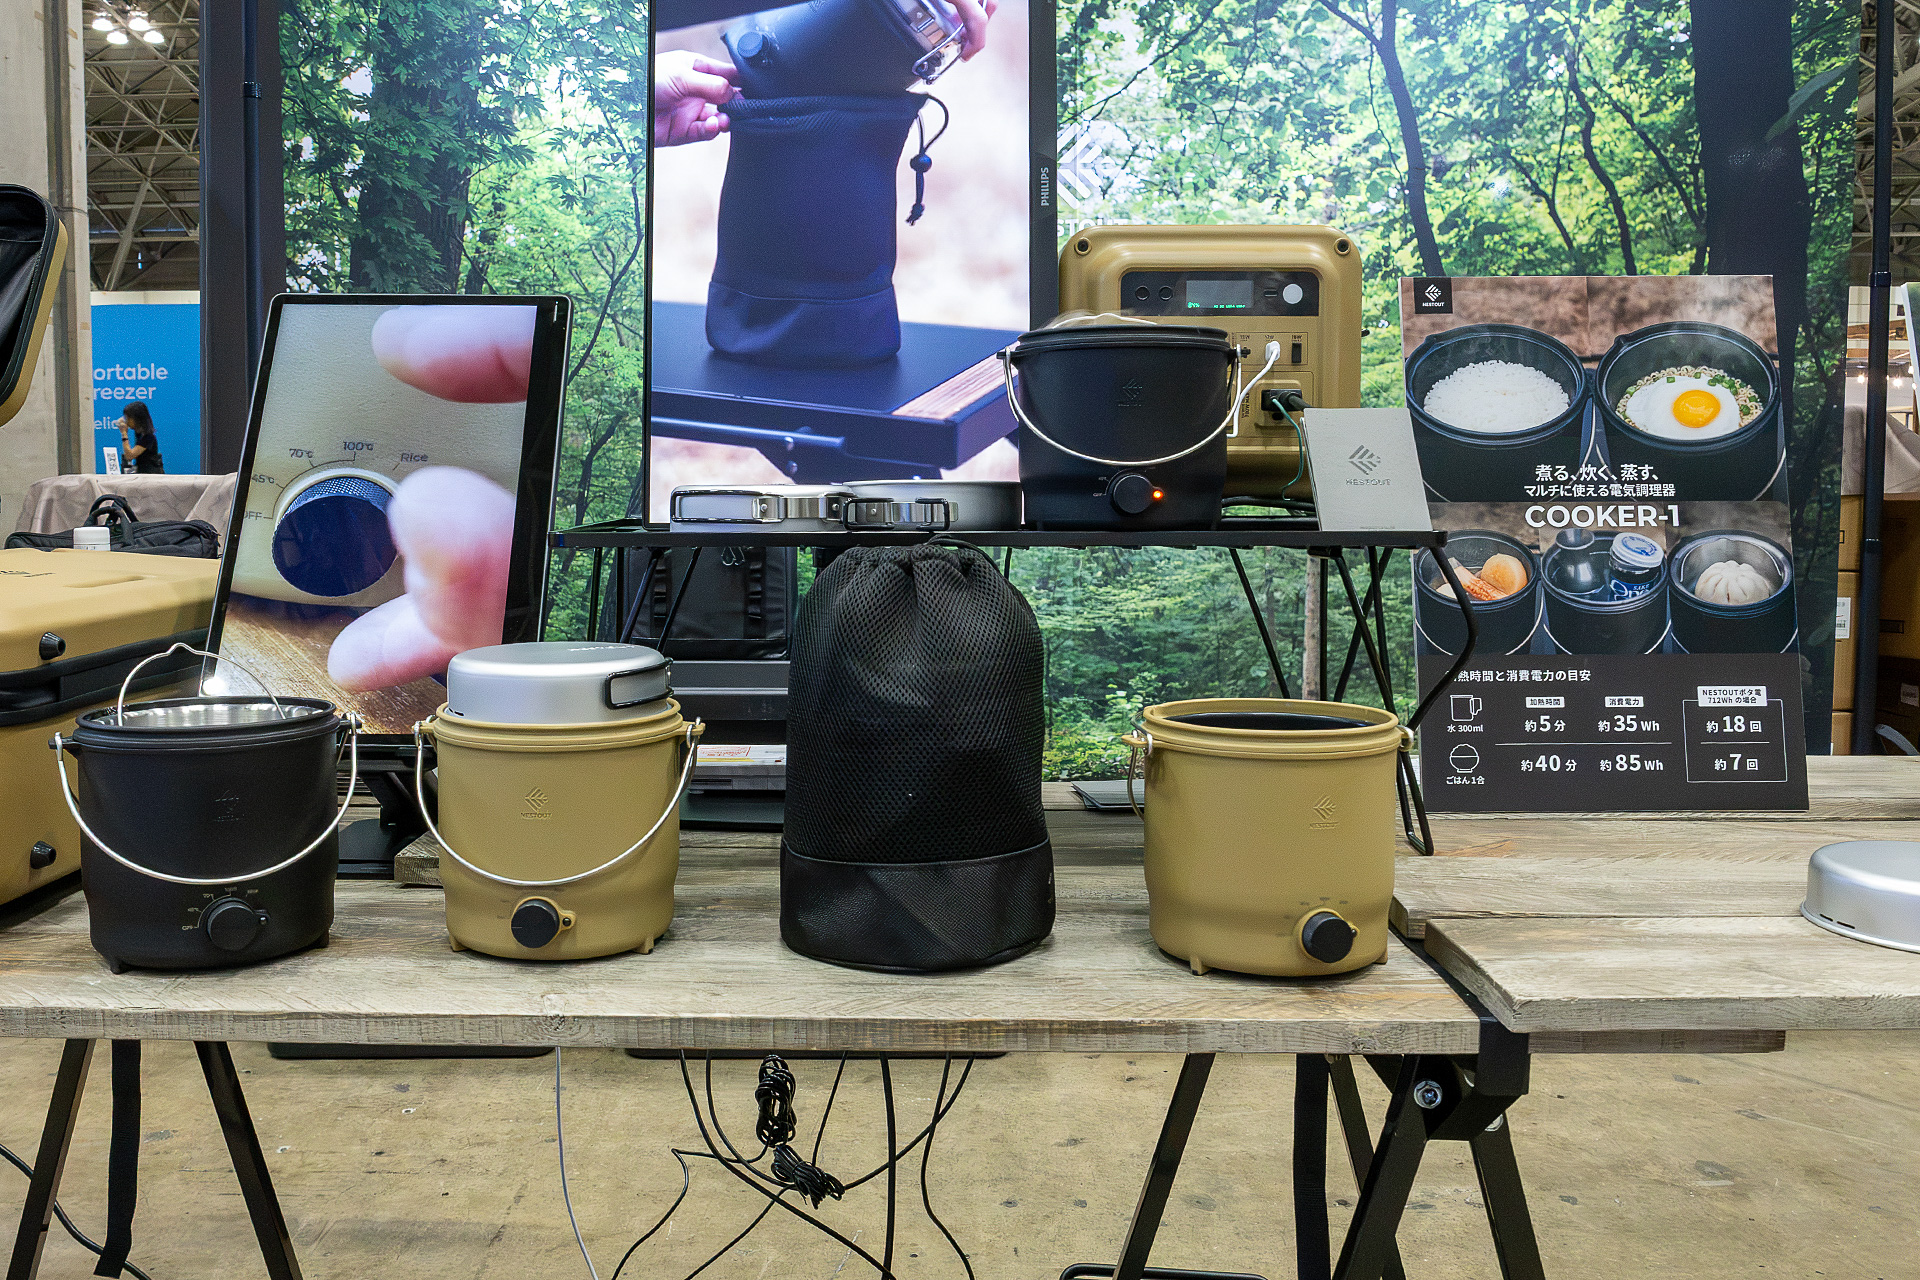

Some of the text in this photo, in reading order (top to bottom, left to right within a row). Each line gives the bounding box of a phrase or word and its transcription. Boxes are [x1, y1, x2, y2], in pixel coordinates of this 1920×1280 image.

[1040, 166, 1050, 207] PHILIPS
[93, 363, 169, 380] ortable
[93, 386, 157, 400] reezer
[400, 452, 429, 462] Rice
[1345, 478, 1391, 486] NESTOUT
[1523, 483, 1676, 498] マルチに使える電気調理器
[1524, 504, 1680, 528] COOKER-1
[1445, 669, 1592, 682] 熱時間と消費電力の目安
[1529, 698, 1561, 706] 加熱時間
[1609, 698, 1640, 706] 消費電力
